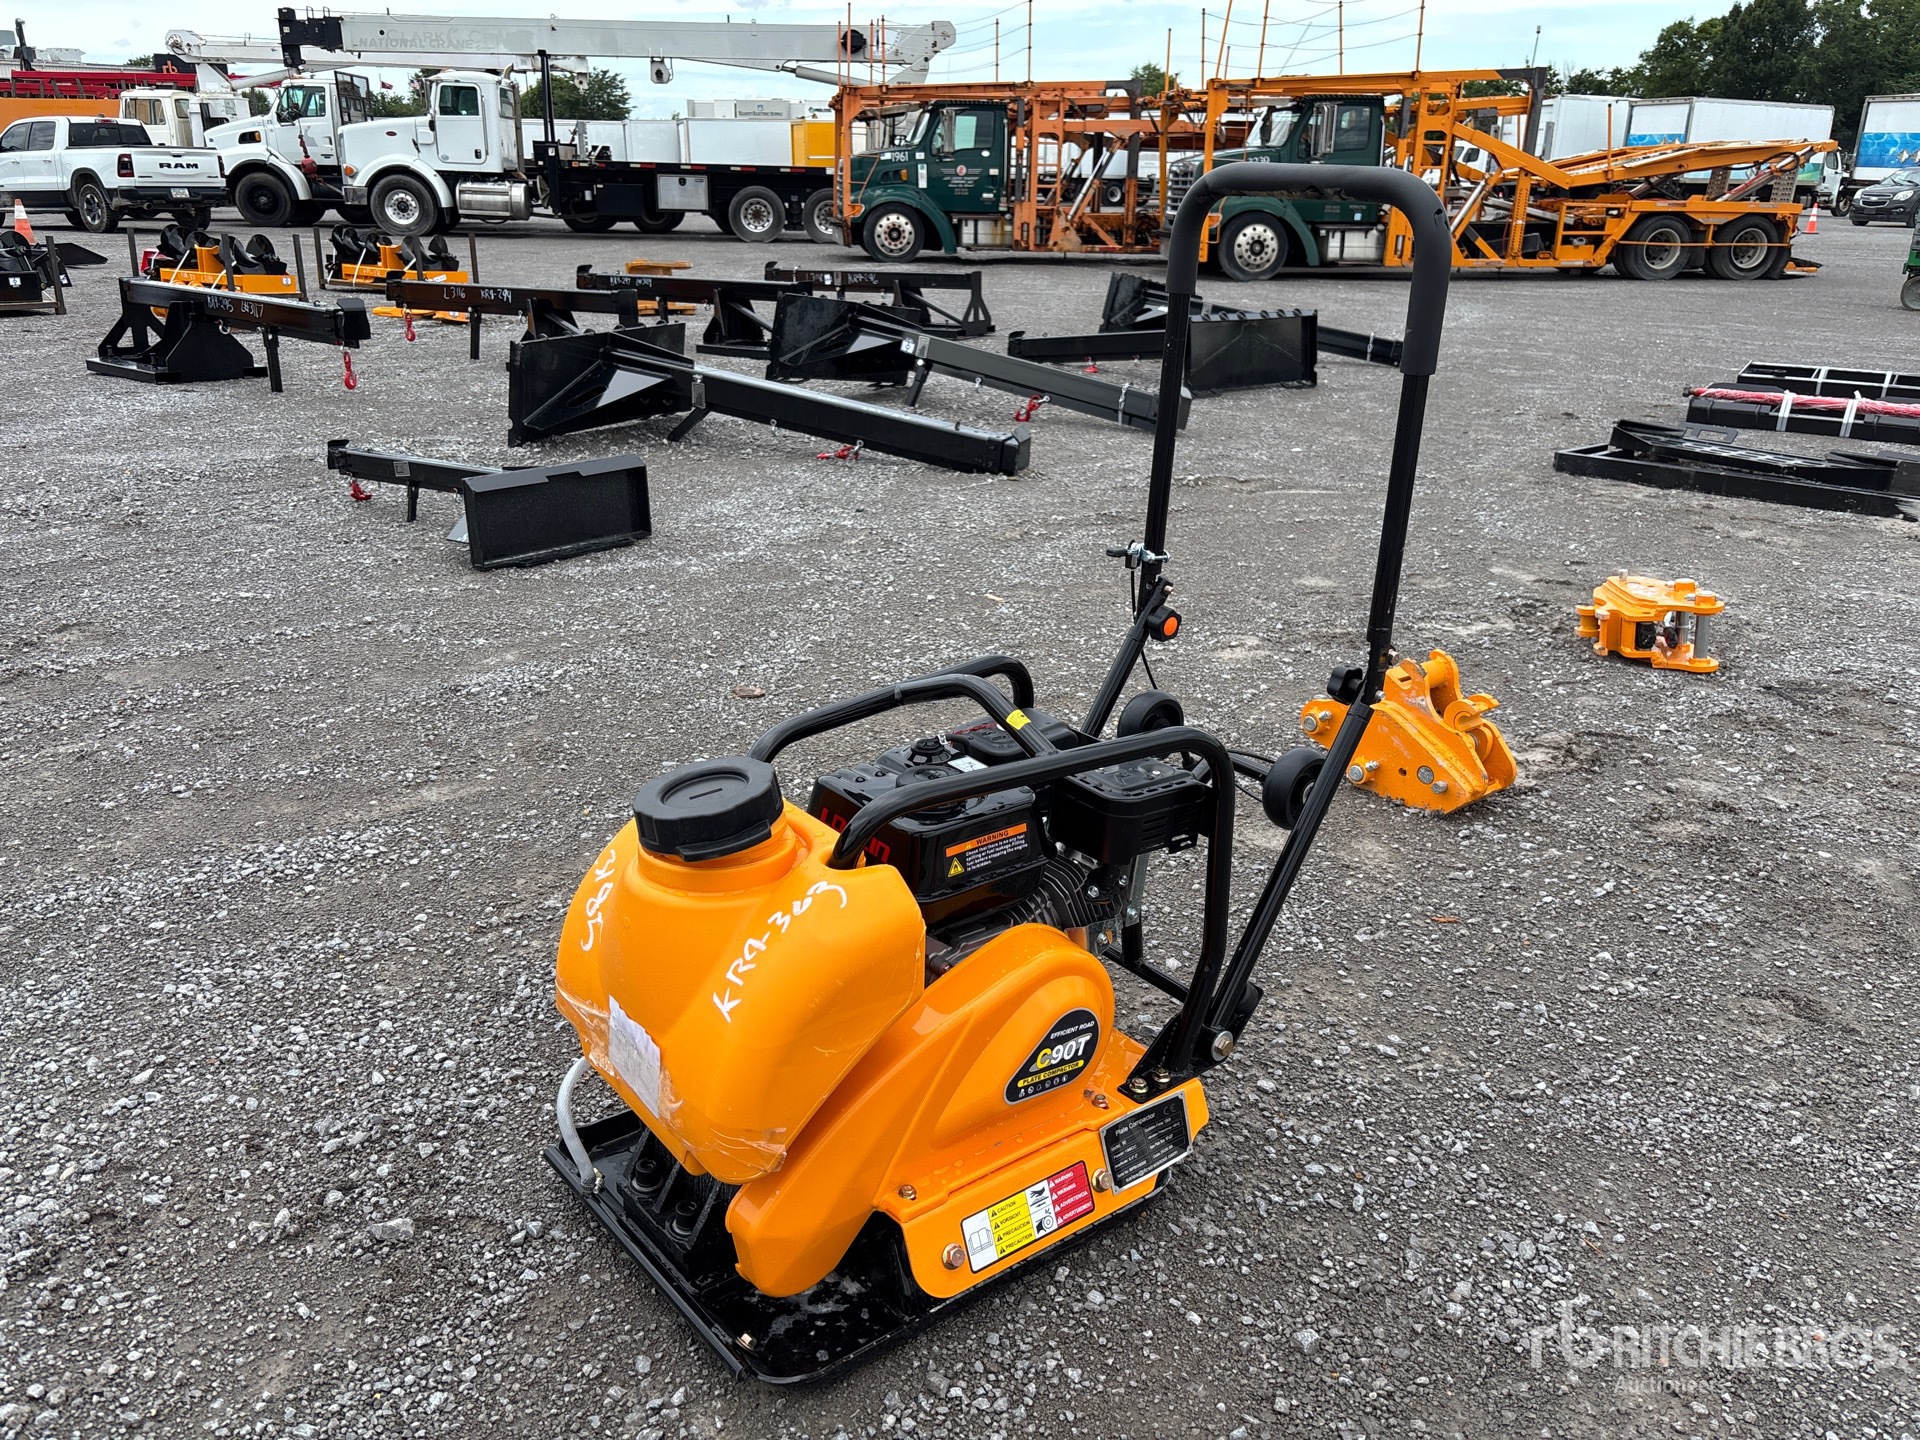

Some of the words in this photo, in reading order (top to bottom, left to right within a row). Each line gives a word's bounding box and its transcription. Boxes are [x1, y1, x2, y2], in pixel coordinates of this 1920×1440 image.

[360, 38, 425, 48] NATIONAL
[429, 39, 474, 49] CRANE
[891, 151, 909, 162] 1961
[975, 830, 1009, 845] WARNING
[965, 849, 979, 857] Check
[987, 842, 998, 850] there
[974, 856, 988, 864] before
[988, 849, 1007, 859] stopping
[1050, 1025, 1079, 1039] EFFICIENT
[1078, 1020, 1095, 1030] ROAD
[1036, 1035, 1091, 1069] C90T
[1022, 1075, 1042, 1085] PLATE
[1043, 1061, 1080, 1079] COMPACTOR
[1115, 1126, 1128, 1136] Plate
[1128, 1112, 1156, 1129] Compactor
[1054, 1171, 1074, 1184] WARNING
[1057, 1183, 1077, 1196] WARNING
[996, 1200, 1017, 1214] CAUTION
[1060, 1191, 1088, 1208] ADVERTENCIA
[999, 1211, 1021, 1225] VORSICHT
[1002, 1220, 1031, 1237] PRECAUCION
[1005, 1232, 1033, 1250] PRECAUTION
